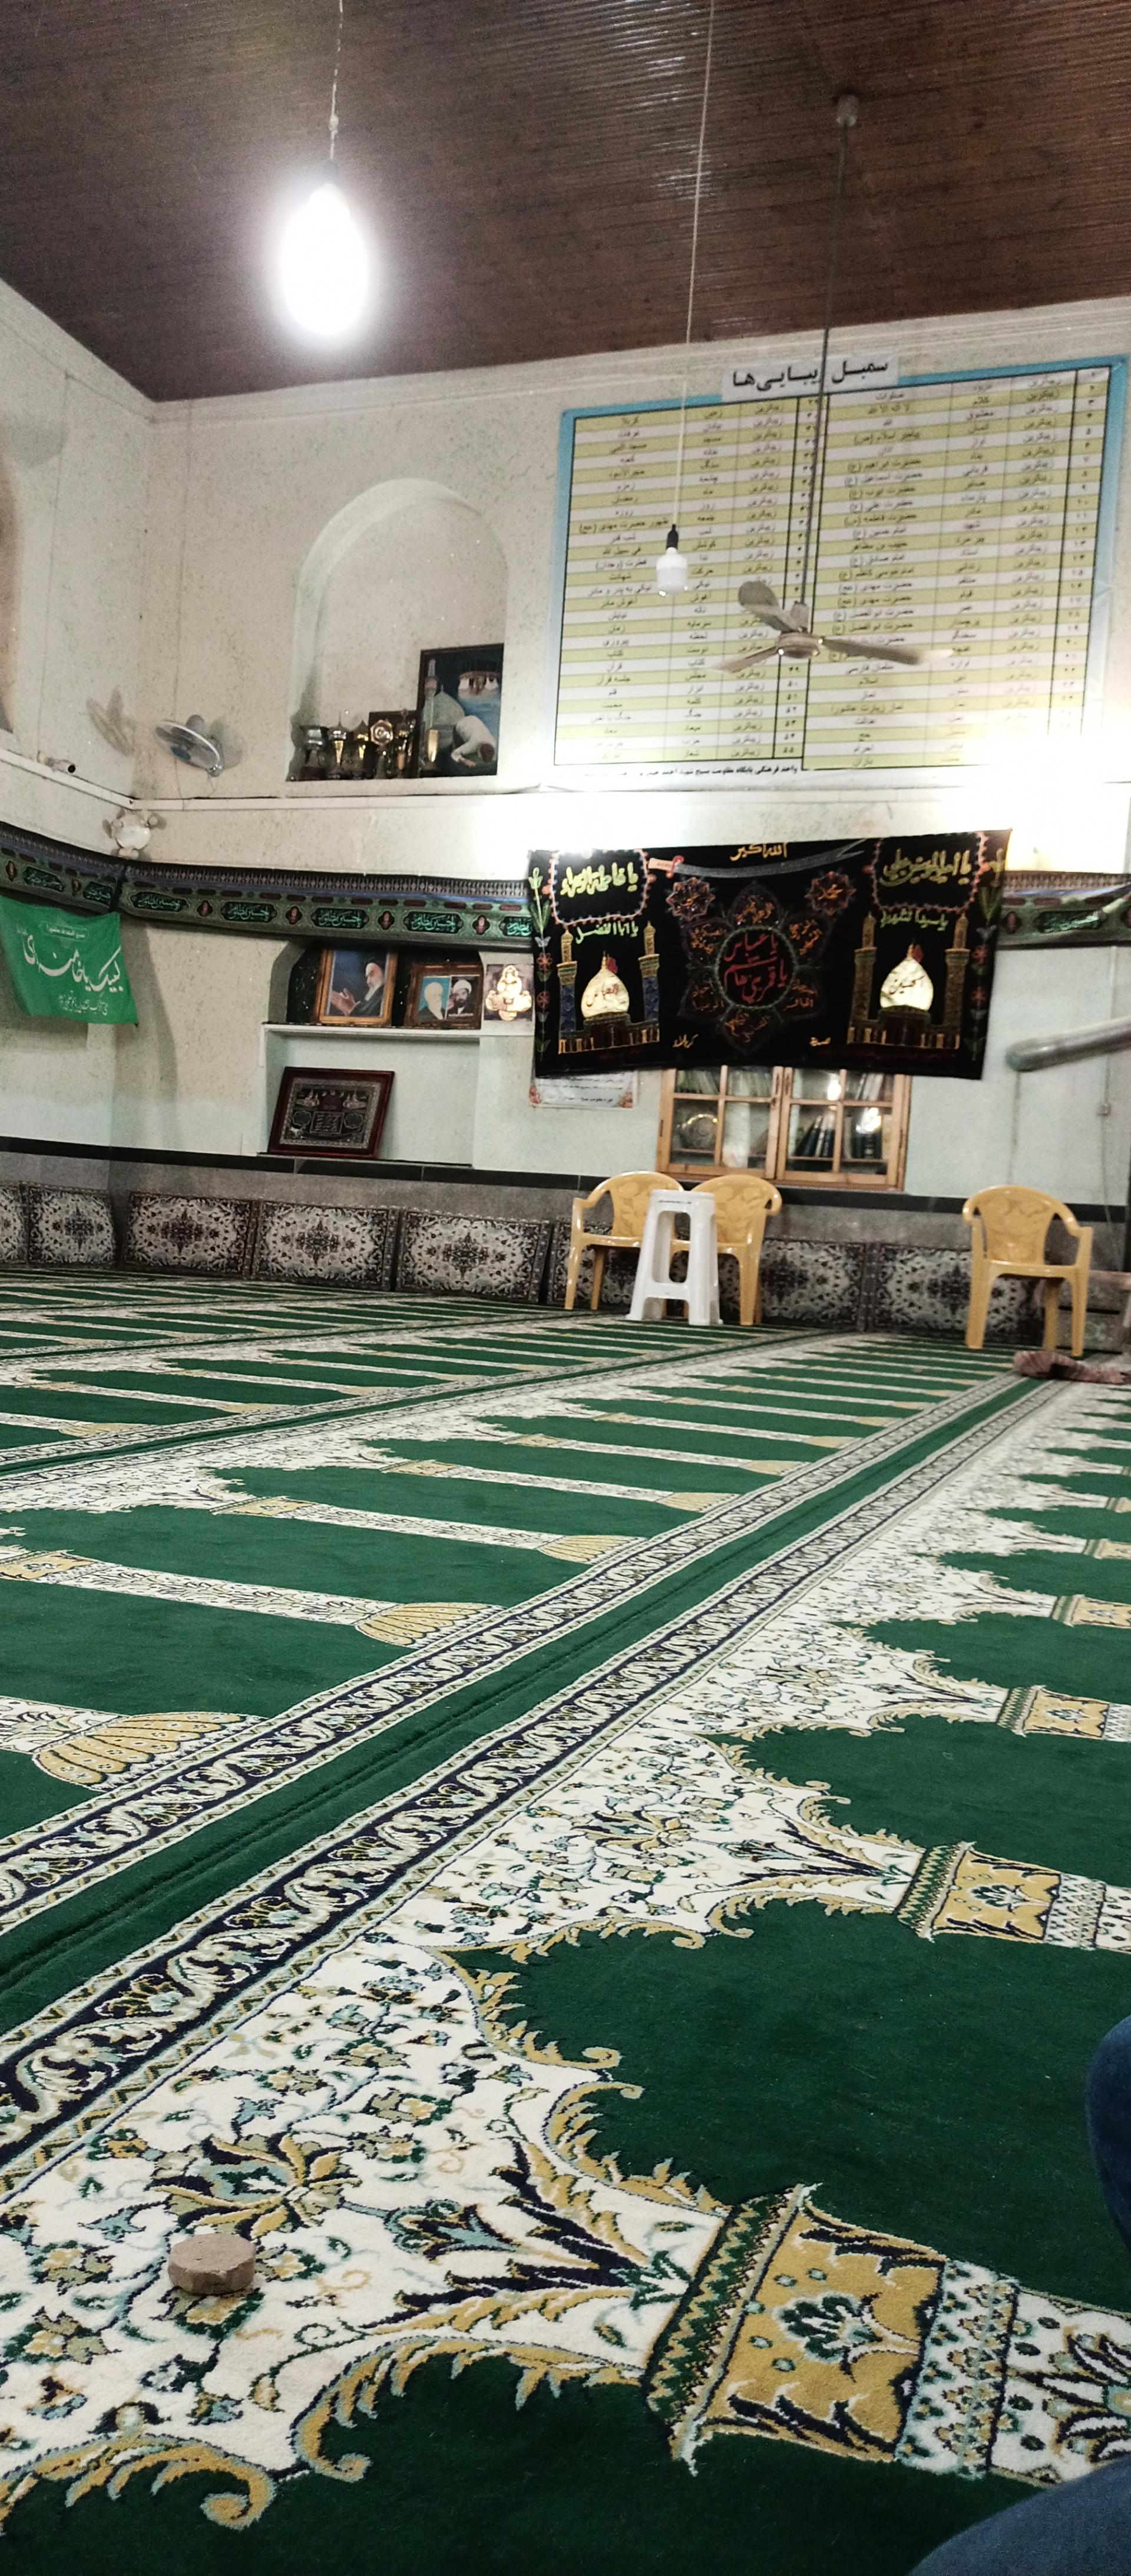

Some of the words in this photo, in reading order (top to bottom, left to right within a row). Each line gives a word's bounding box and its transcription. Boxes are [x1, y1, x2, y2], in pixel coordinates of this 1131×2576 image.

[831, 360, 888, 383] سمبل
[729, 842, 768, 862] اکبر
[958, 849, 973, 886] یا
[626, 861, 639, 892] یا
[89, 945, 124, 993] لبیک
